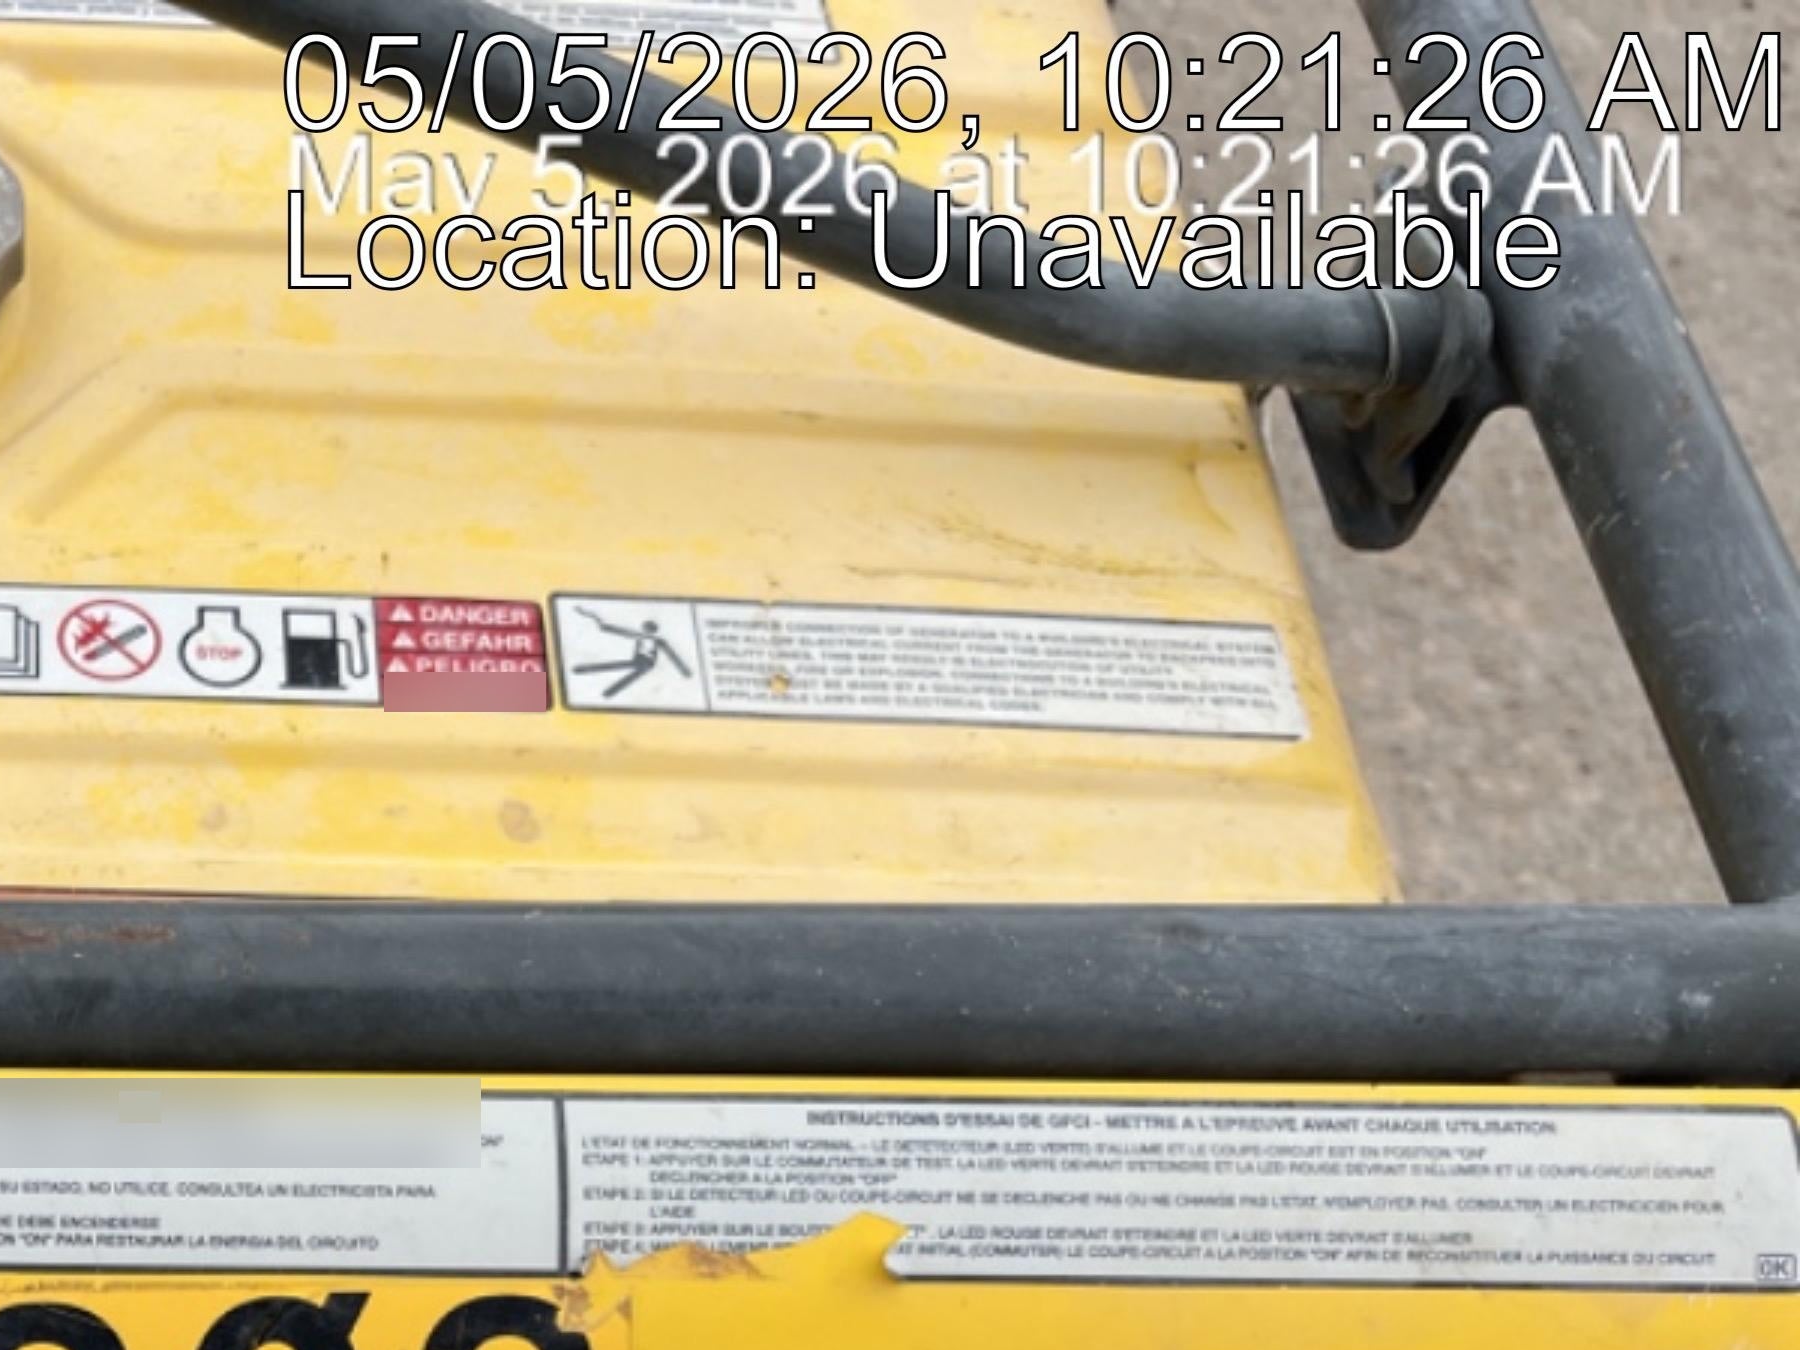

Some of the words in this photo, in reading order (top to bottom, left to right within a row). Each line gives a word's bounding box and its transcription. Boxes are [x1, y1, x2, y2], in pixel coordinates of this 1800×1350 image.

[419, 603, 530, 626] DANGER
[421, 630, 532, 652] GEFAHR
[196, 644, 243, 660] STOP
[807, 1111, 940, 1127] INSTRUCTIONS
